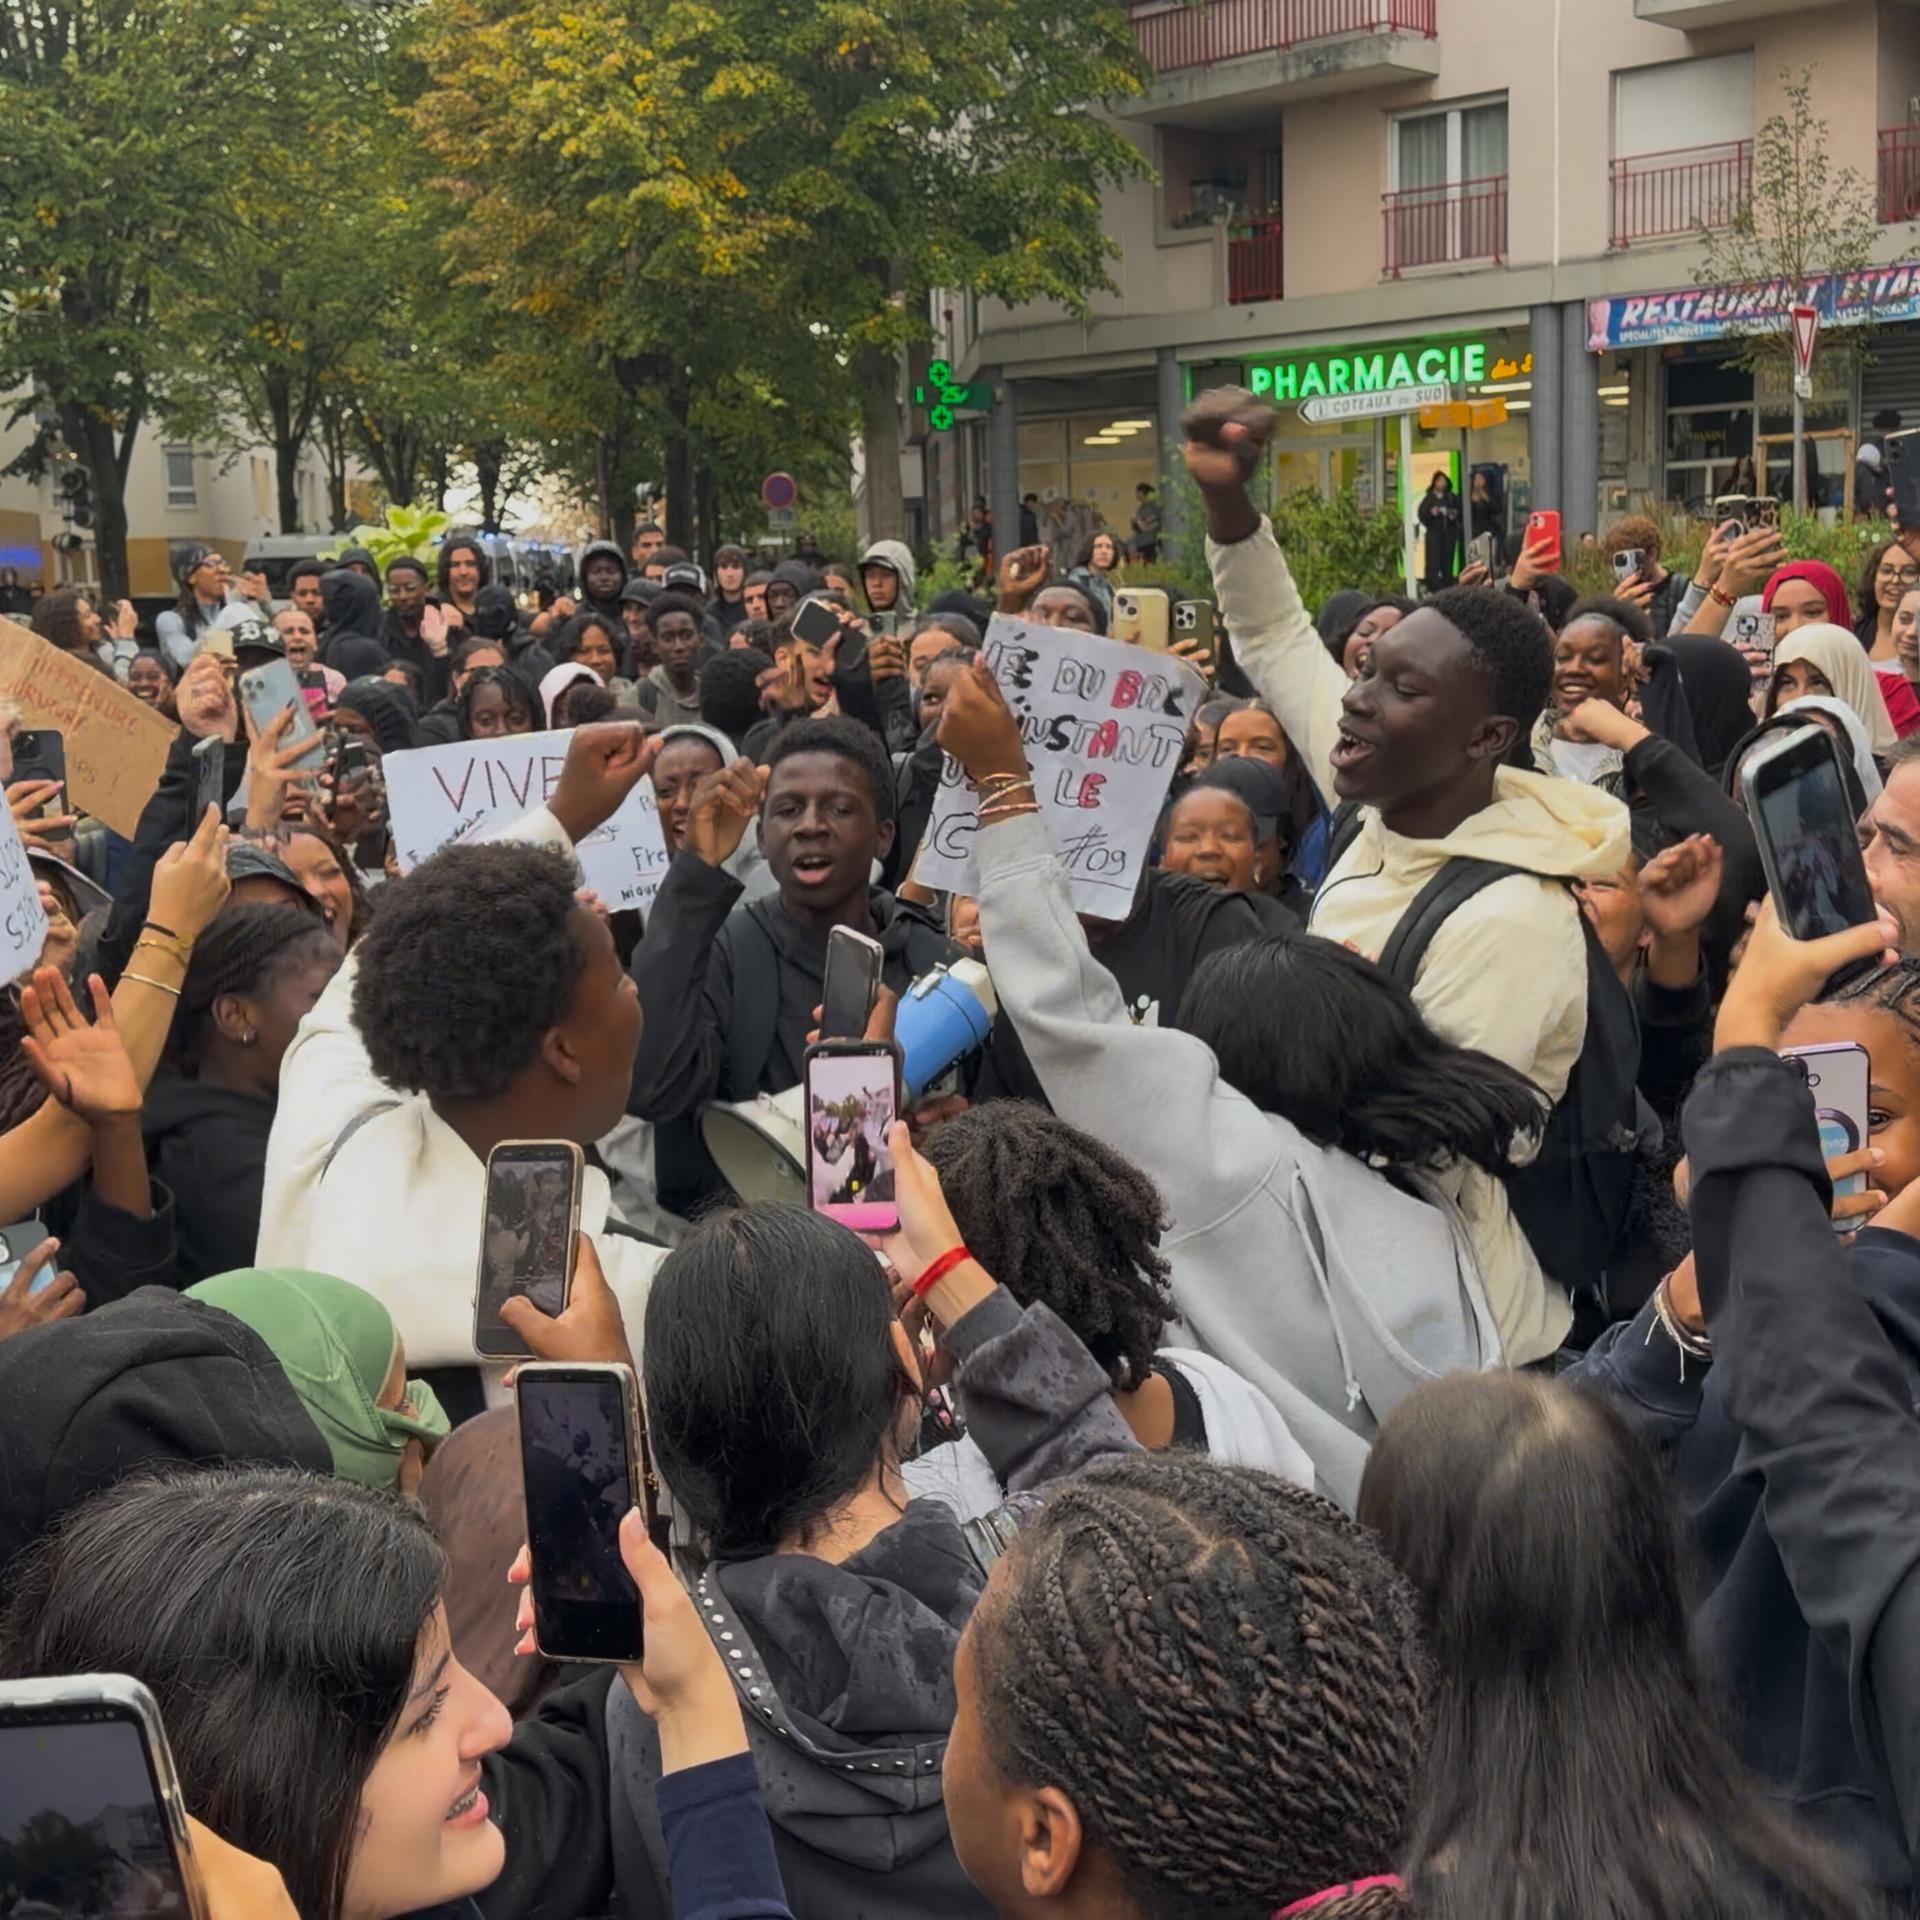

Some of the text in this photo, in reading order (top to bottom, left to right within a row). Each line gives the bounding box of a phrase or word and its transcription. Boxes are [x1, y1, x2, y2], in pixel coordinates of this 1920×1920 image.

[1251, 343, 1485, 400] PHARMACIE
[1332, 394, 1393, 413] COTEAUX
[1415, 387, 1442, 401] SUD
[1051, 656, 1106, 701] DU
[432, 756, 566, 813] VIVE
[1054, 767, 1107, 809] LE
[1055, 823, 1127, 876] #09
